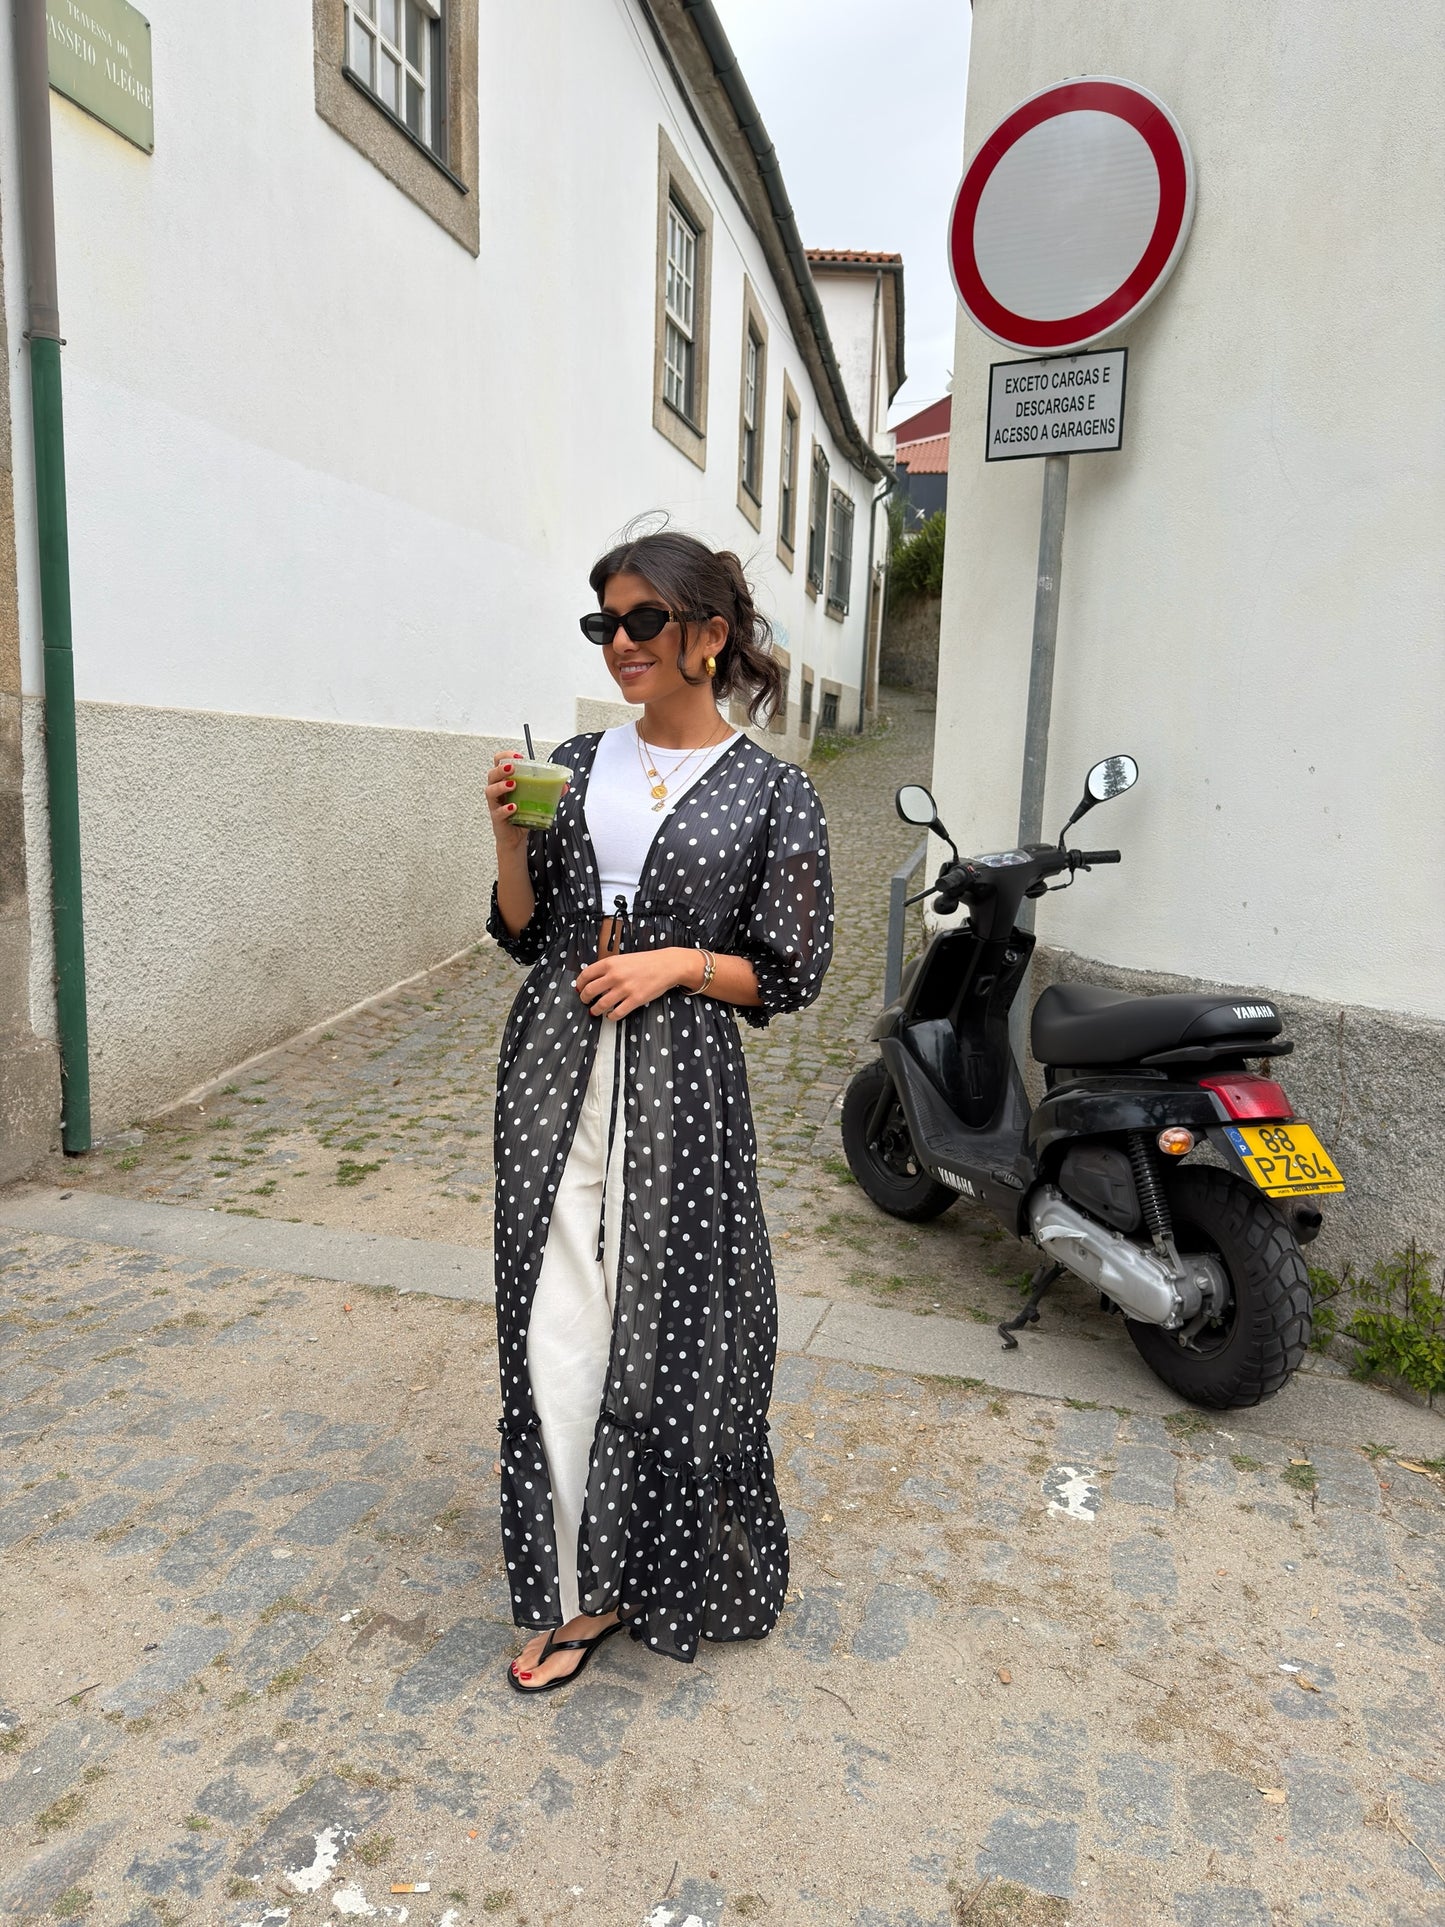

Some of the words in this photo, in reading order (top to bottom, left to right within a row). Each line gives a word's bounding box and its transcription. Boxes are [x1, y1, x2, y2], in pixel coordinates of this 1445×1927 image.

[67, 0, 112, 47] TRAVESSA
[116, 40, 128, 59] DO
[104, 57, 152, 110] ALEGRE
[1005, 374, 1048, 394] EXCETO
[1052, 368, 1099, 389] CARGAS
[1102, 367, 1111, 383] E
[1016, 395, 1084, 418] DESCARGAS
[1087, 394, 1096, 410] E
[993, 425, 1038, 444] ACESSO
[1040, 424, 1049, 440] A
[1051, 418, 1115, 439] GARAGENS
[1232, 1005, 1276, 1019] YAMAHA
[1258, 1128, 1295, 1153] 88
[937, 1166, 976, 1197] YAMAHA
